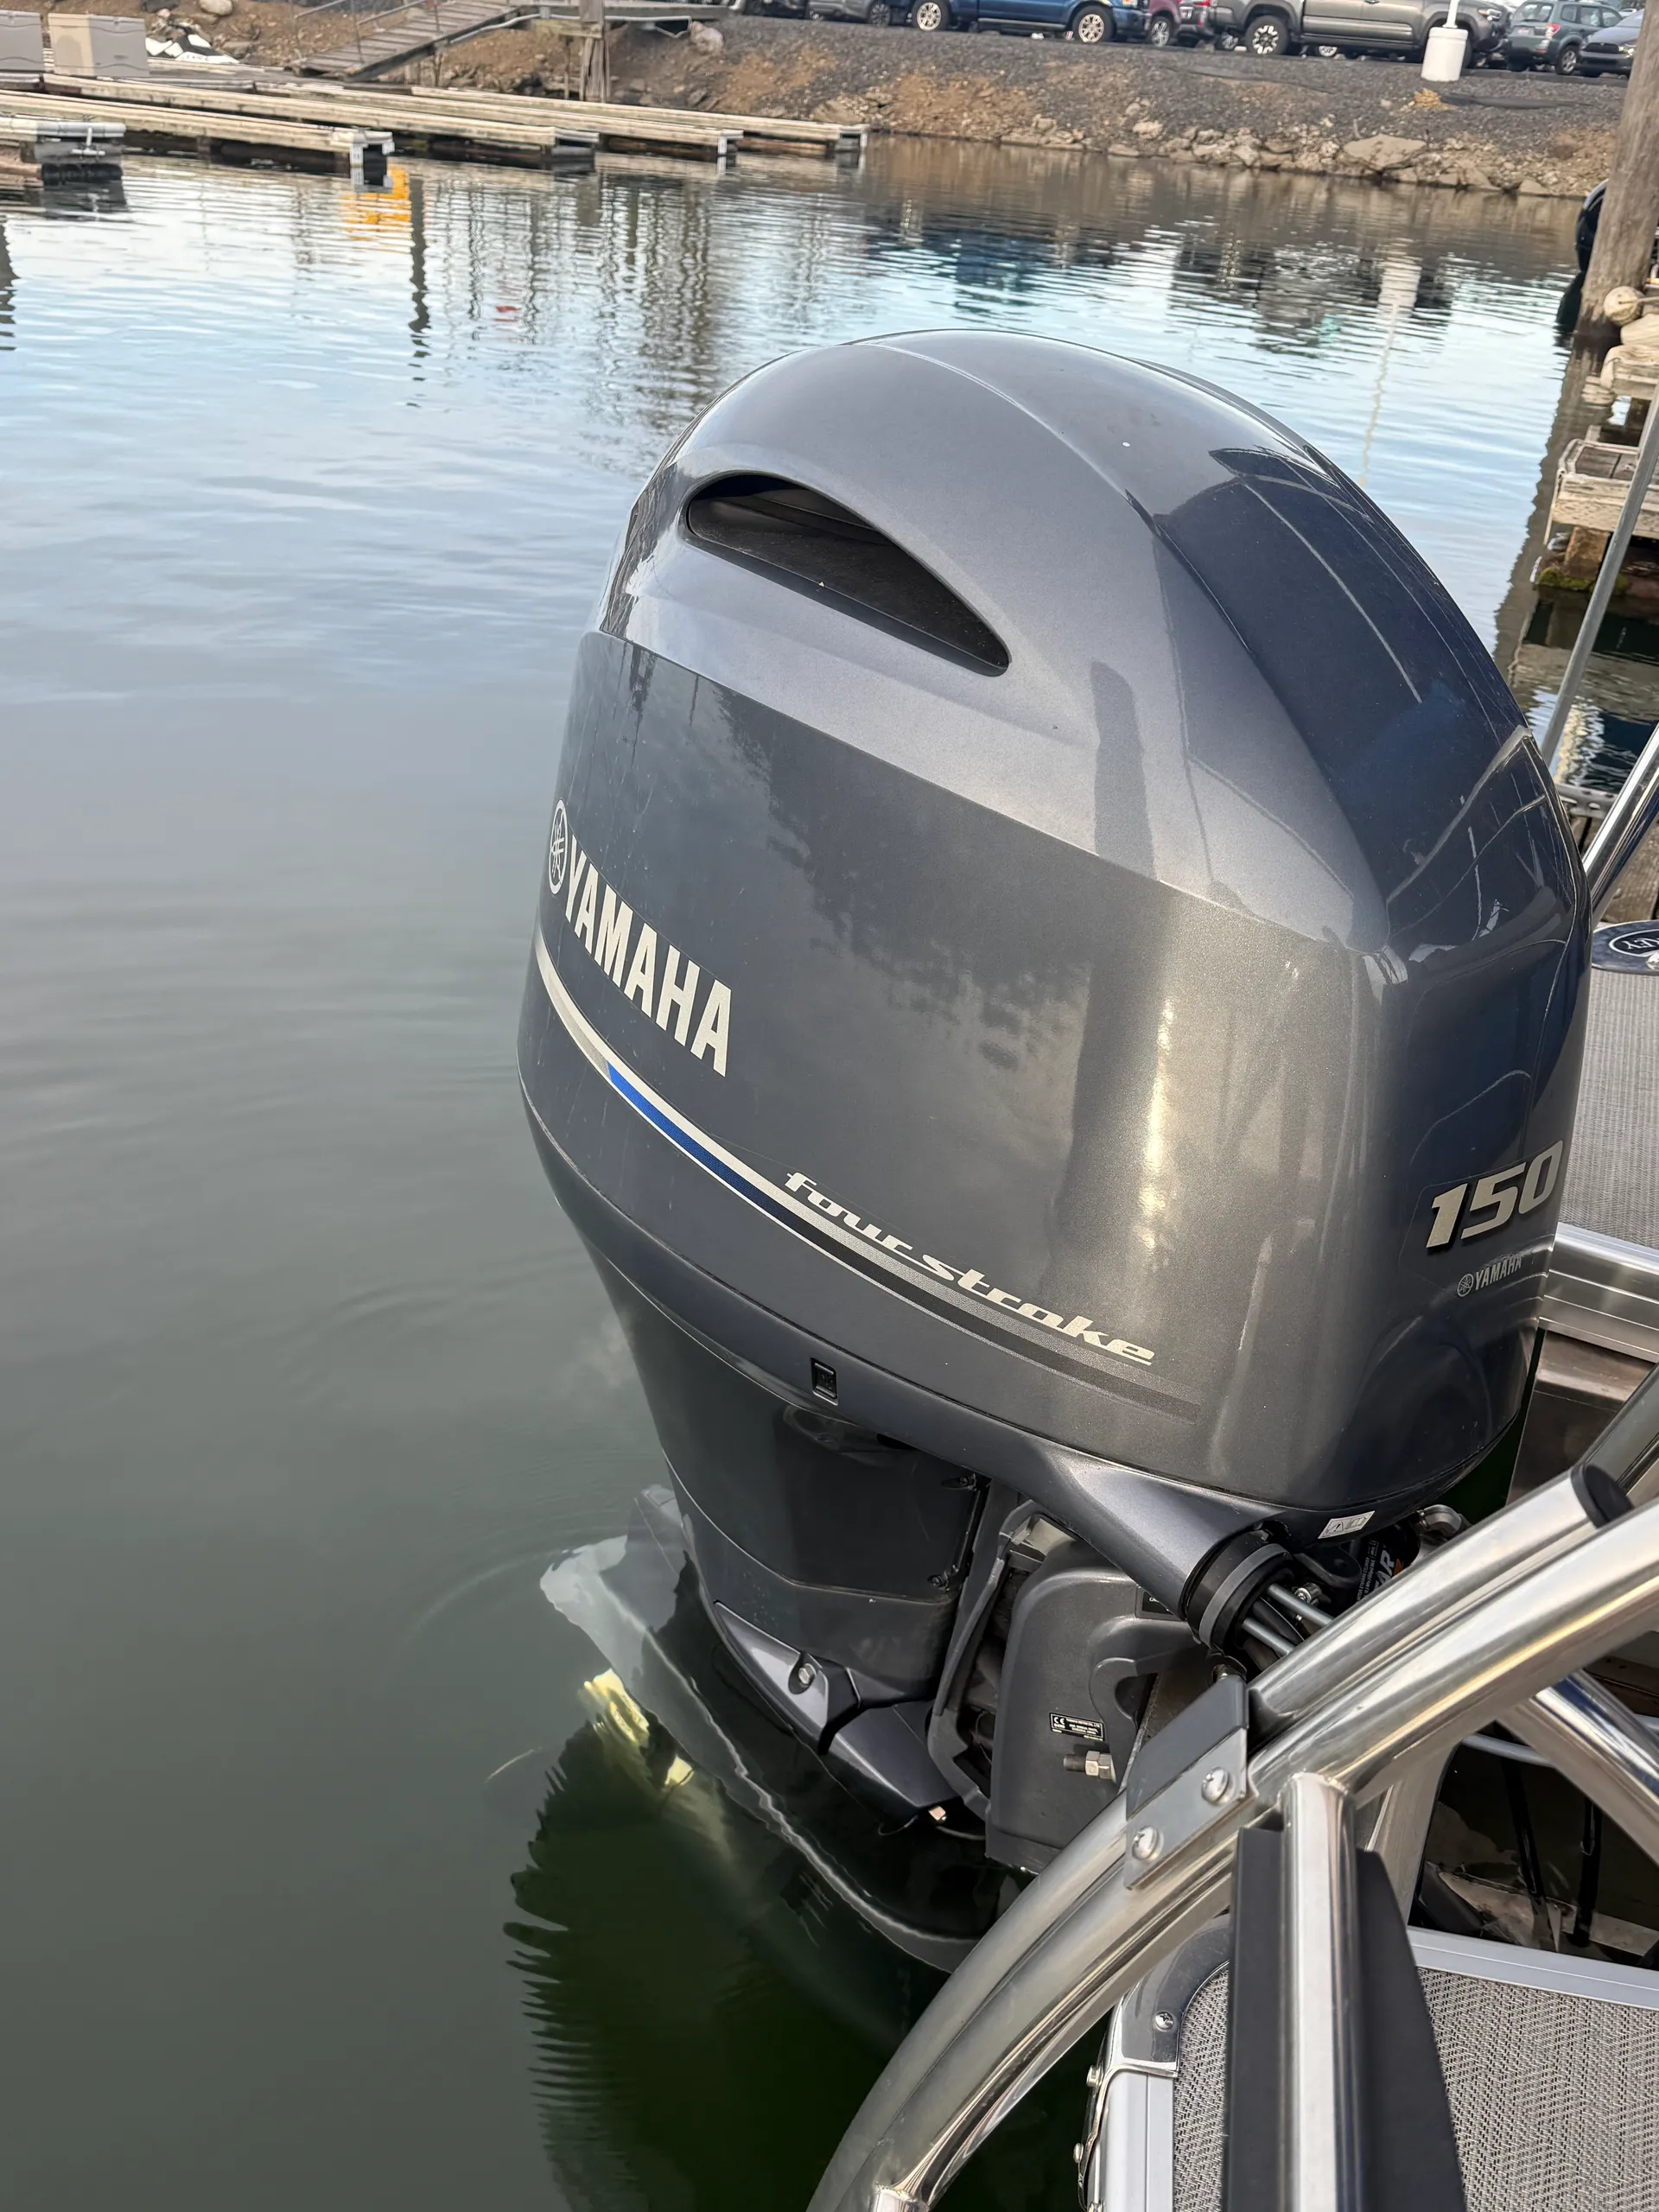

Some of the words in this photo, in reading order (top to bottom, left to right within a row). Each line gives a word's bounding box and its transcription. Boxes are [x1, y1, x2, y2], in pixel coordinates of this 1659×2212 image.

[565, 834, 732, 1077] YAMAHA
[786, 1172, 1156, 1366] fourstroke
[1426, 1141, 1563, 1248] 150
[1475, 1254, 1522, 1290] YAMAHA
